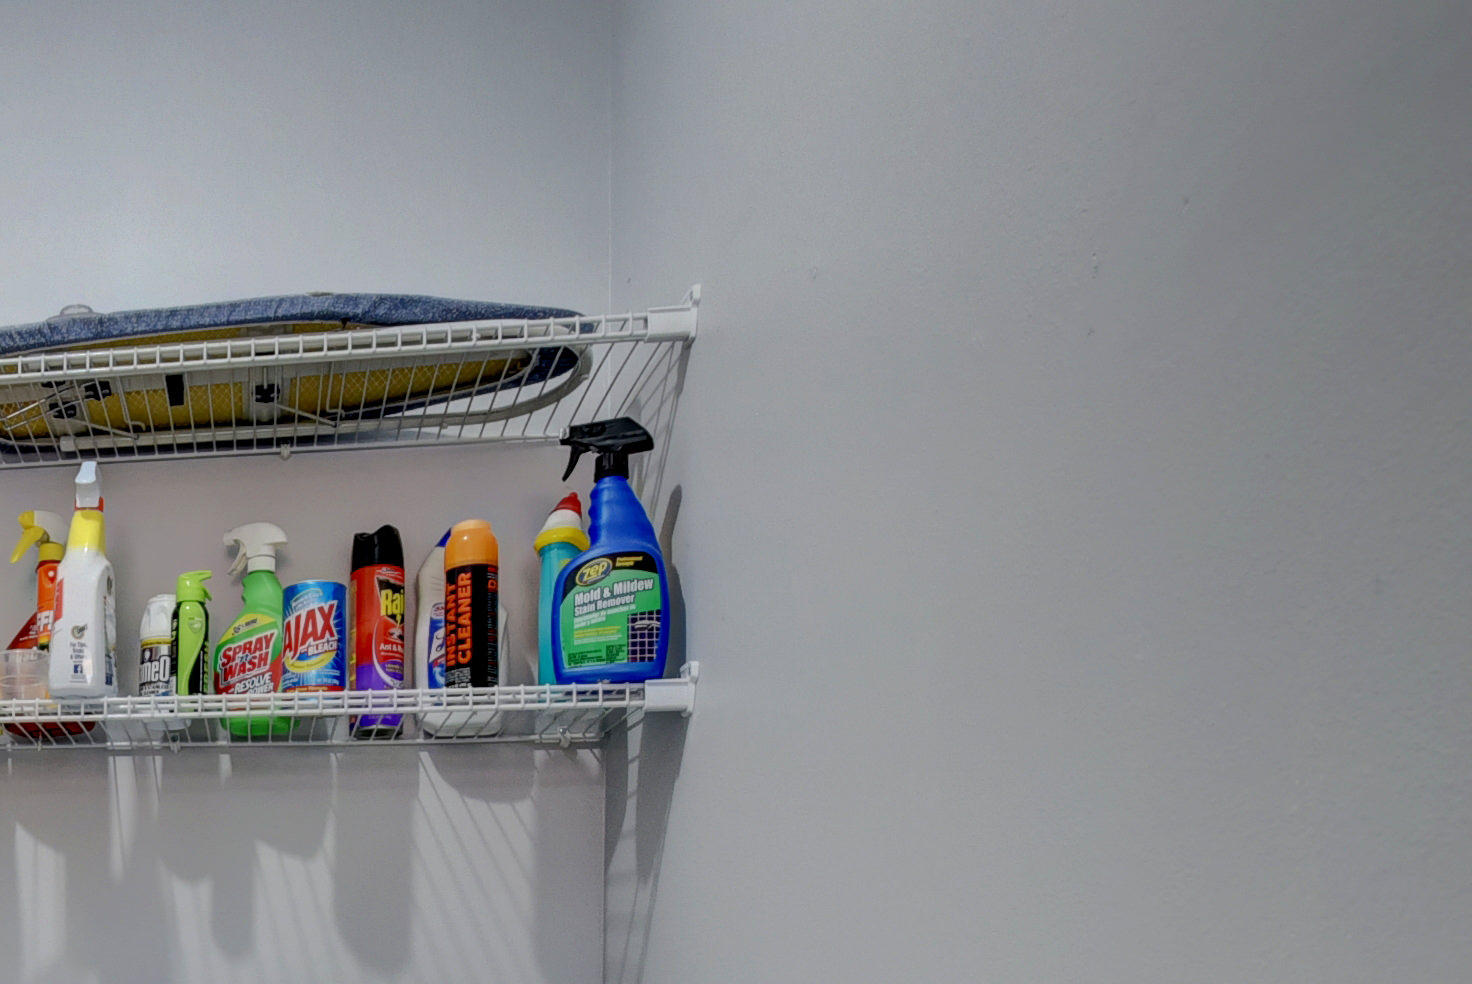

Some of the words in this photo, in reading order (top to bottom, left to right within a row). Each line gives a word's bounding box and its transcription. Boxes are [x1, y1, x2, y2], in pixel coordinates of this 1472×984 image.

[380, 589, 404, 616] Rai
[574, 588, 601, 607] Mold
[603, 587, 612, 598] &
[613, 578, 654, 596] Mildew
[574, 603, 596, 617] Stain
[597, 594, 635, 611] Remover
[283, 603, 336, 660] AJAX
[446, 582, 457, 667] INSTANT
[457, 572, 472, 665] CLEANER
[221, 631, 276, 668] SPRAY
[223, 652, 270, 682] WASH
[234, 672, 273, 694] RESOLVE
